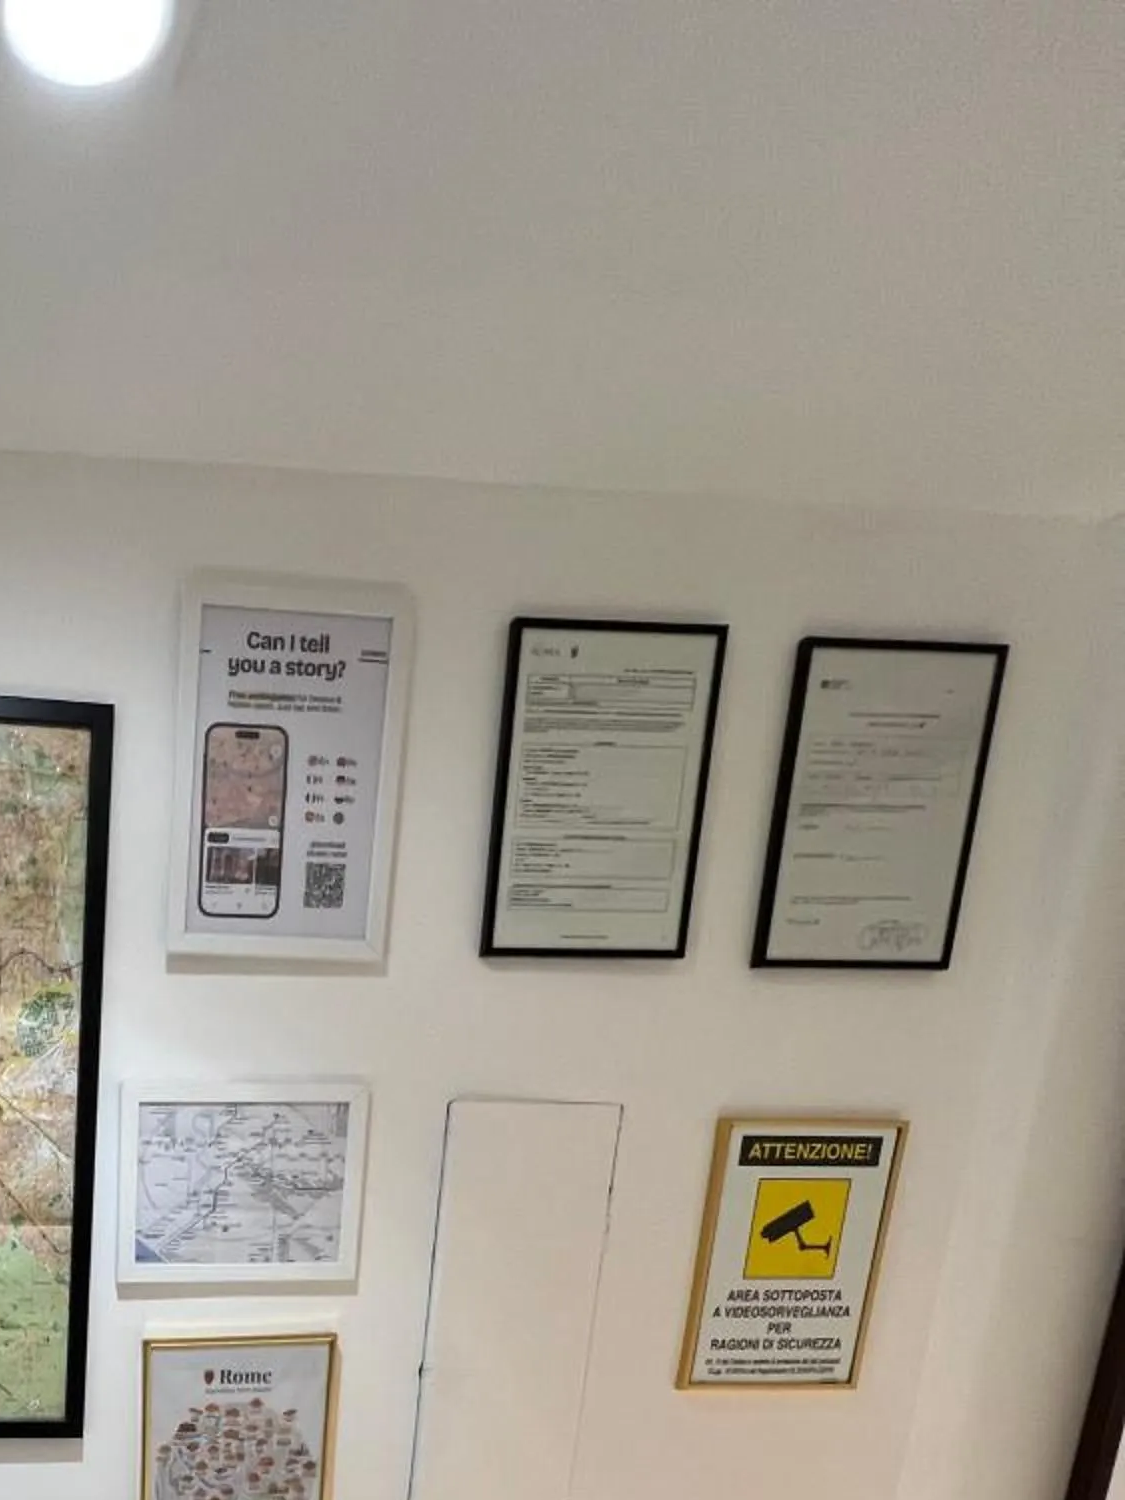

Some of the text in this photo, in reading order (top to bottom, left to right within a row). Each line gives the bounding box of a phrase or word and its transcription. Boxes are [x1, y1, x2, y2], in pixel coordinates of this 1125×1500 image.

[246, 631, 330, 653] Can I tell
[227, 657, 346, 681] you a story?
[747, 1143, 873, 1160] ATTENZIONE!
[726, 1289, 843, 1302] AREA SOTTOPOSTA
[712, 1305, 851, 1319] A VIDEOSORVEGLIANZA
[766, 1321, 793, 1335] PER
[710, 1337, 842, 1351] RAGIONI DI SICUREZZA
[219, 1369, 273, 1385] Rome
